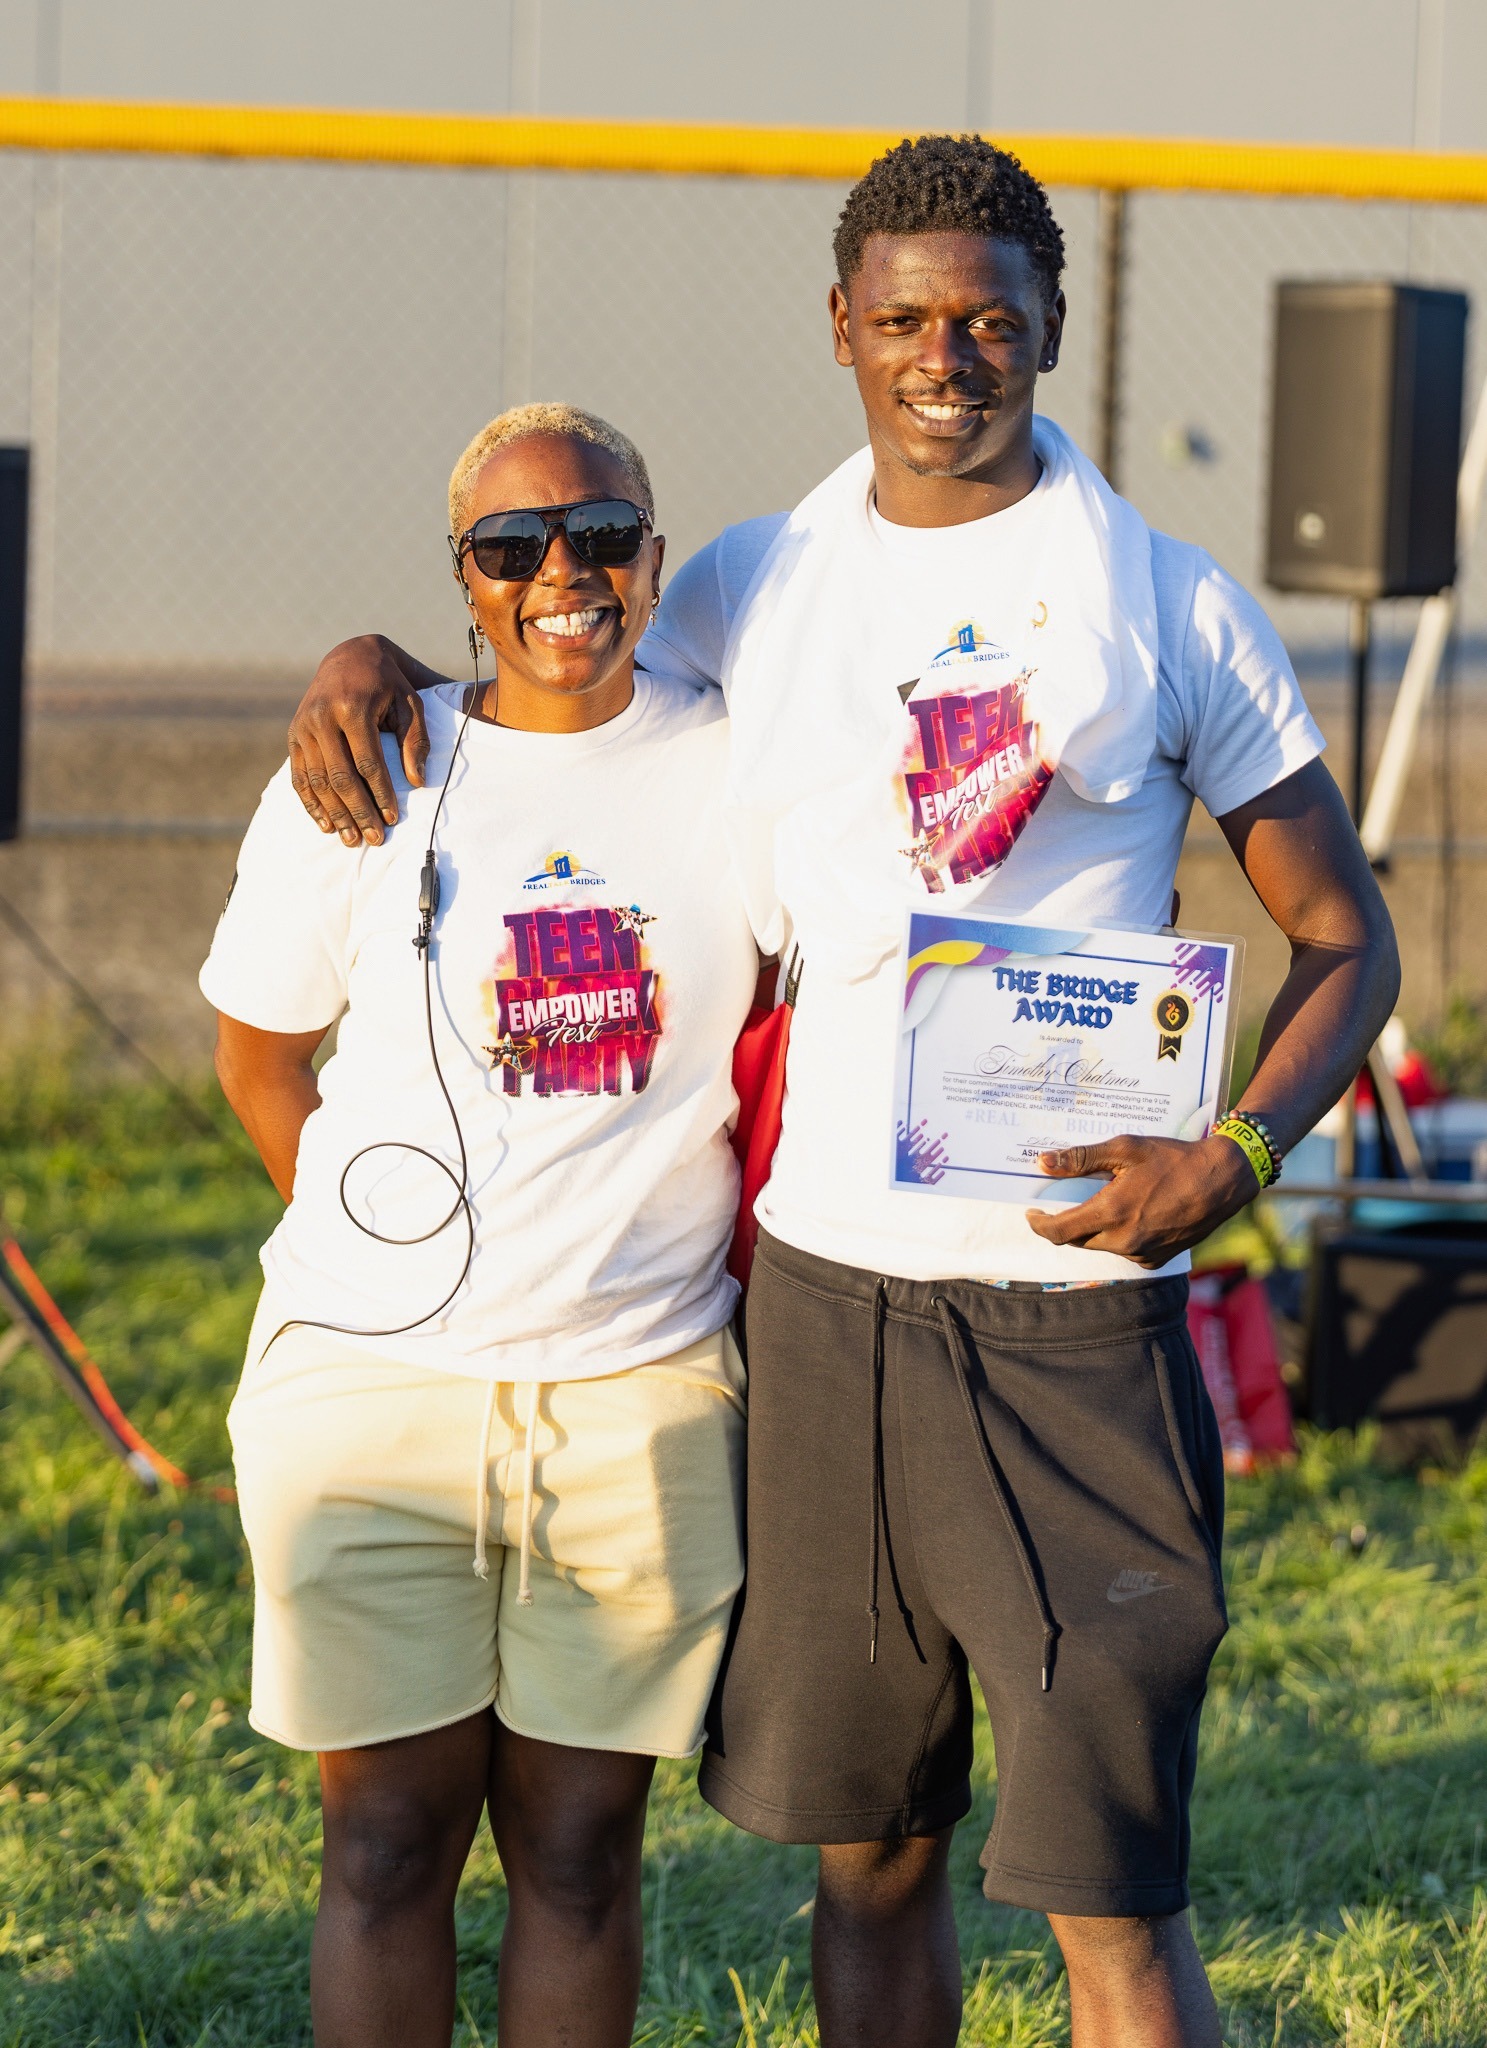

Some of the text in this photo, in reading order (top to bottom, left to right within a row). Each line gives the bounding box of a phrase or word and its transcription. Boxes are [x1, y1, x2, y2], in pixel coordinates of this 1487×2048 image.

[920, 742, 1026, 828] EMPOWER
[503, 908, 638, 978] TEEN
[992, 966, 1140, 1005] THE BRIDGE
[508, 987, 638, 1033] EMPOWER
[1012, 997, 1113, 1030] AWARD
[531, 1015, 611, 1048] Fest
[1046, 1035, 1075, 1044] Awarded
[1077, 1037, 1084, 1045] to
[503, 1033, 656, 1094] PARTY
[975, 1045, 1141, 1092] Timothy Chatmon
[942, 1085, 972, 1095] Principles
[953, 1077, 967, 1085] their
[968, 1080, 1009, 1089] commitment
[1017, 1084, 1044, 1094] uplifting
[1045, 1086, 1056, 1094] the
[1056, 1088, 1092, 1099] community
[1093, 1091, 1105, 1099] and
[1106, 1094, 1141, 1104] embodying
[1159, 1098, 1170, 1106] Life
[1225, 1123, 1254, 1142] VIP
[1005, 1155, 1032, 1164] Founder
[1021, 1149, 1039, 1158] ASH
[1247, 1144, 1262, 1154] VIP
[1115, 1569, 1158, 1589] NIKE
